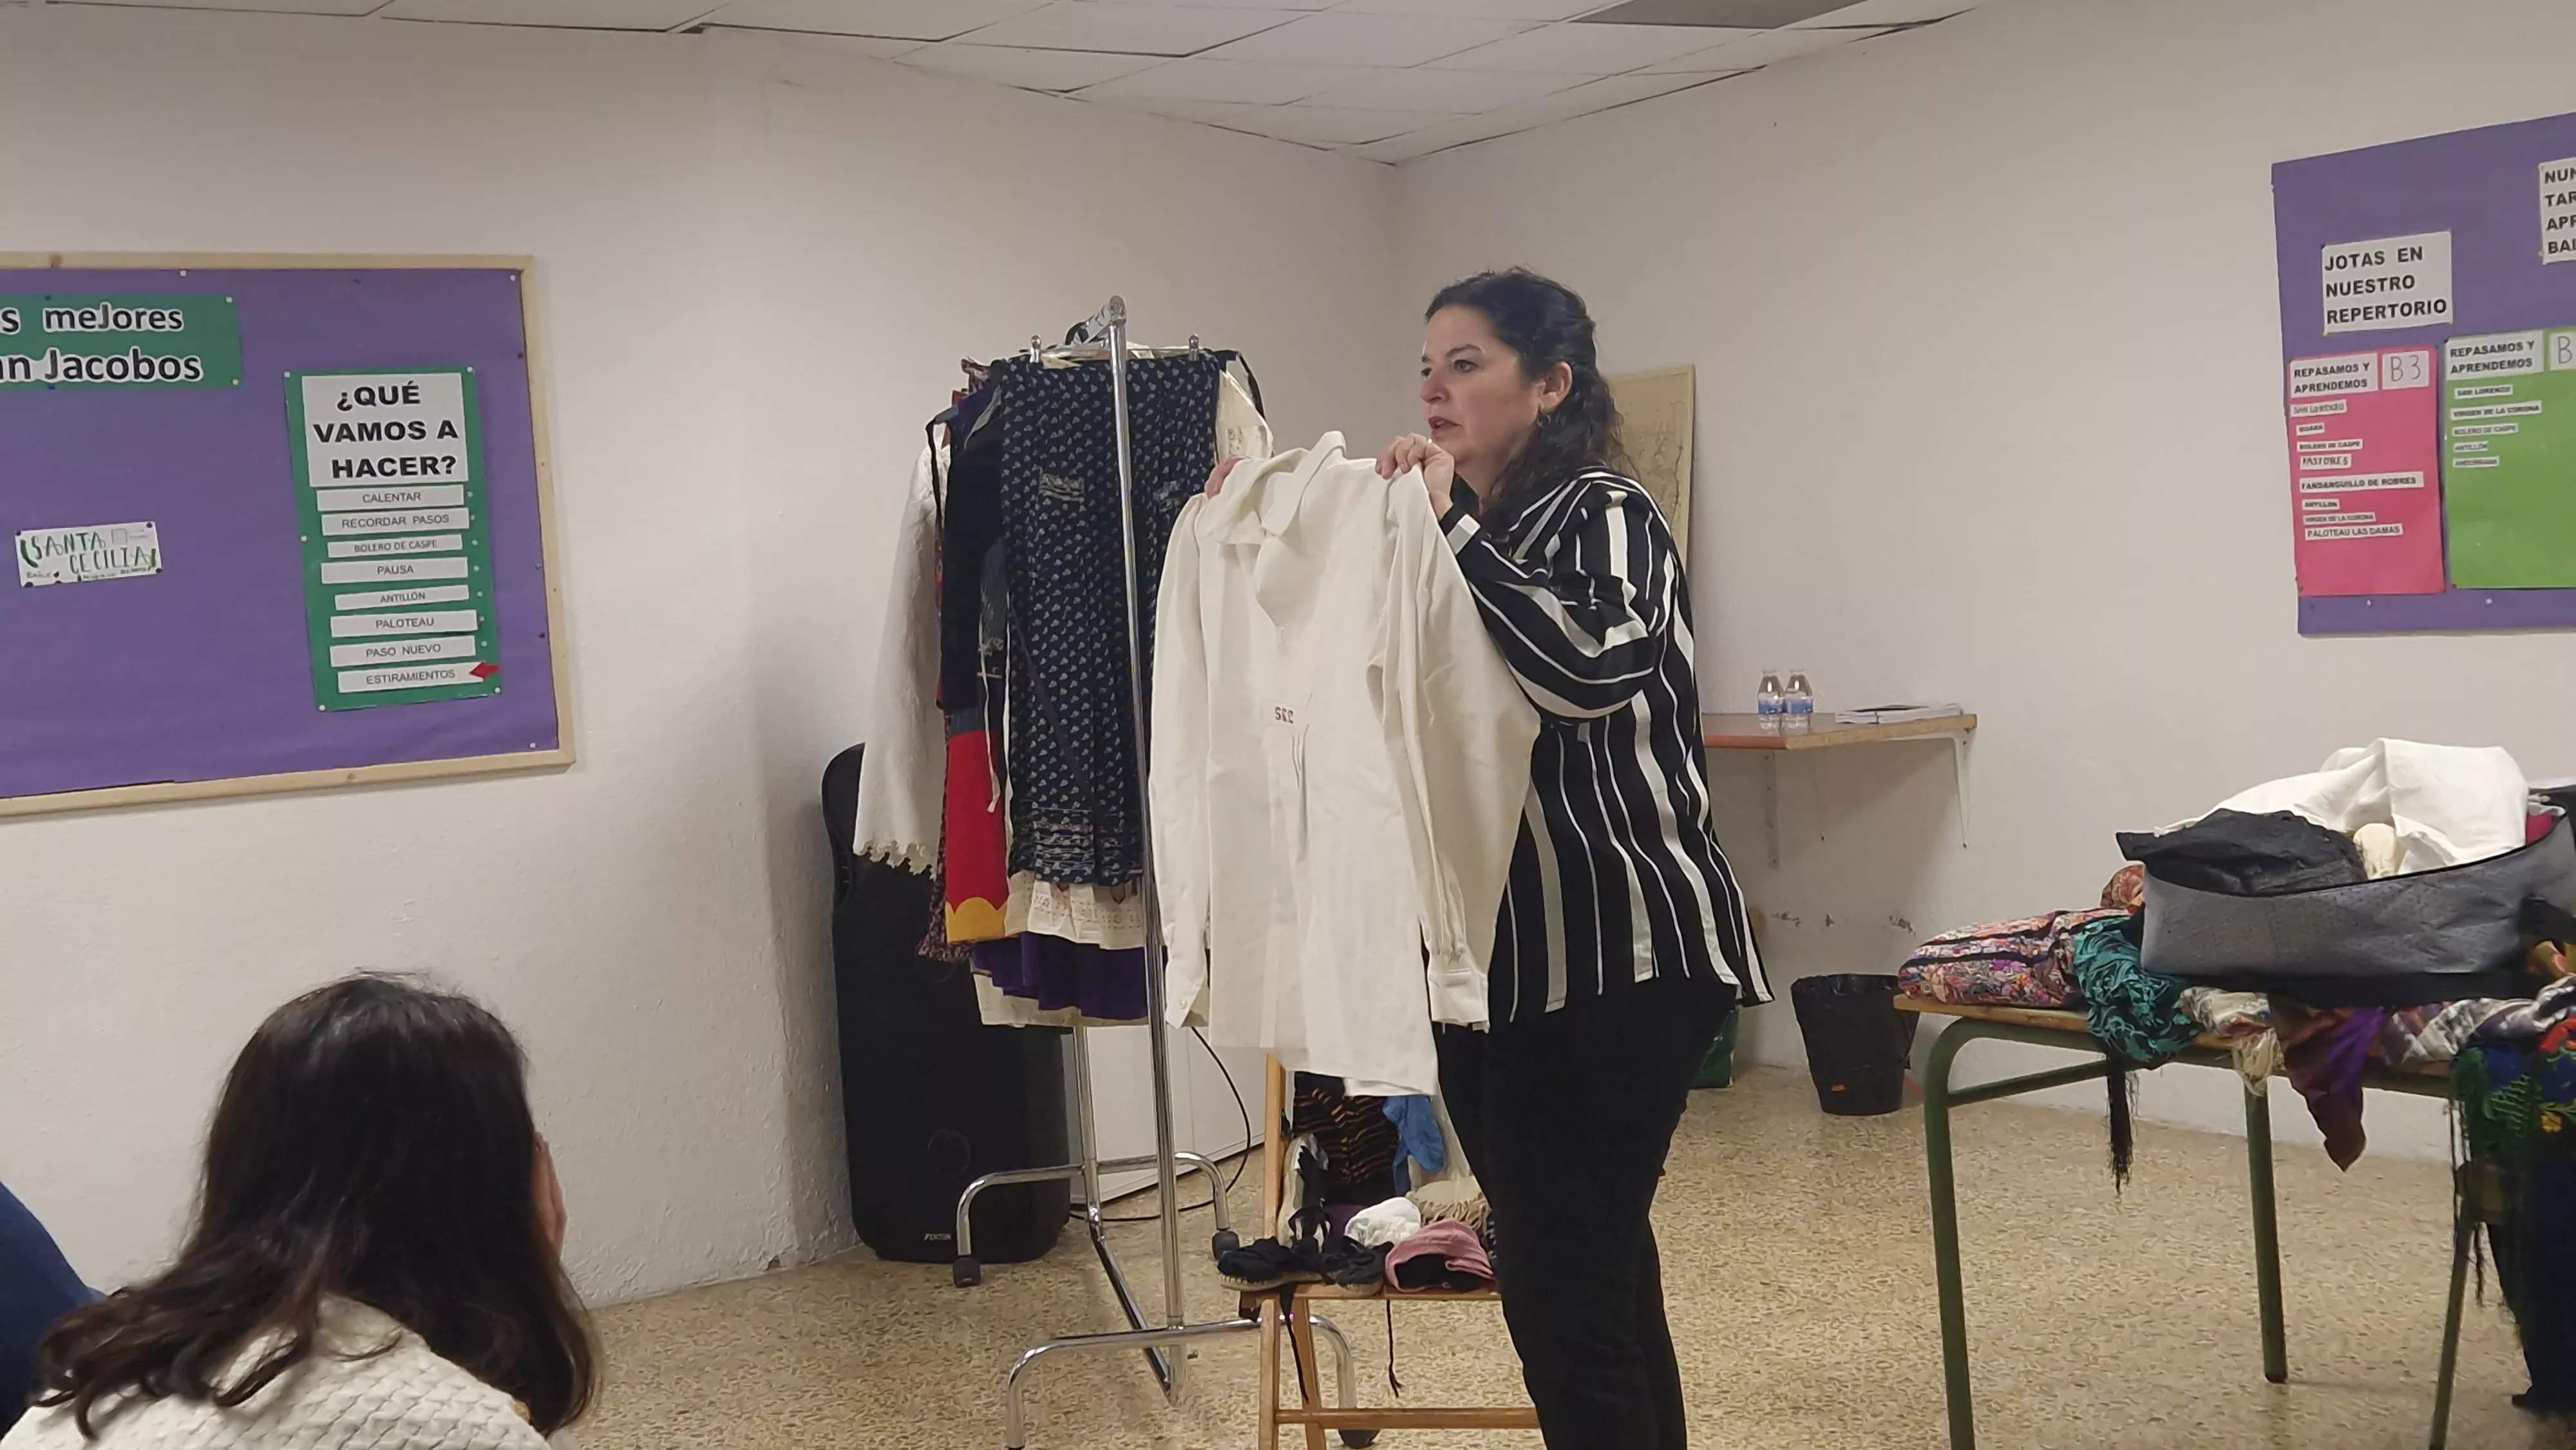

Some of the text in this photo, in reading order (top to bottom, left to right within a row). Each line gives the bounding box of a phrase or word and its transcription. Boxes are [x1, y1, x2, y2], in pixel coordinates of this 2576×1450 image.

[2324, 246, 2423, 271] JOTAS EN
[2325, 274, 2415, 298] NUESTRO
[2327, 299, 2447, 325] REPERTORIO
[2450, 340, 2535, 358] REPASAMOS Y
[44, 348, 201, 381] Jacobos
[2294, 362, 2371, 378] REPASAMOS Y
[2450, 357, 2533, 374] APRENDEMOS
[2294, 379, 2368, 393] APRENDEMOS
[337, 380, 421, 411] ¿QUÉ
[313, 420, 459, 443] VAMOS A
[332, 455, 456, 479] HACER?
[362, 491, 421, 504] CALENTAR
[341, 514, 450, 529] RECORDAR PASOS
[2307, 525, 2400, 538] PALOTEAU LAS DAMAS
[31, 531, 106, 560] SANTA
[354, 539, 438, 553] BOLERO DE CASPE
[377, 564, 414, 575] PAUSA
[375, 617, 434, 629] PALOTEAU
[366, 643, 441, 658] PASO NUEVO
[366, 669, 456, 684] ESTIRAMIENTOS
